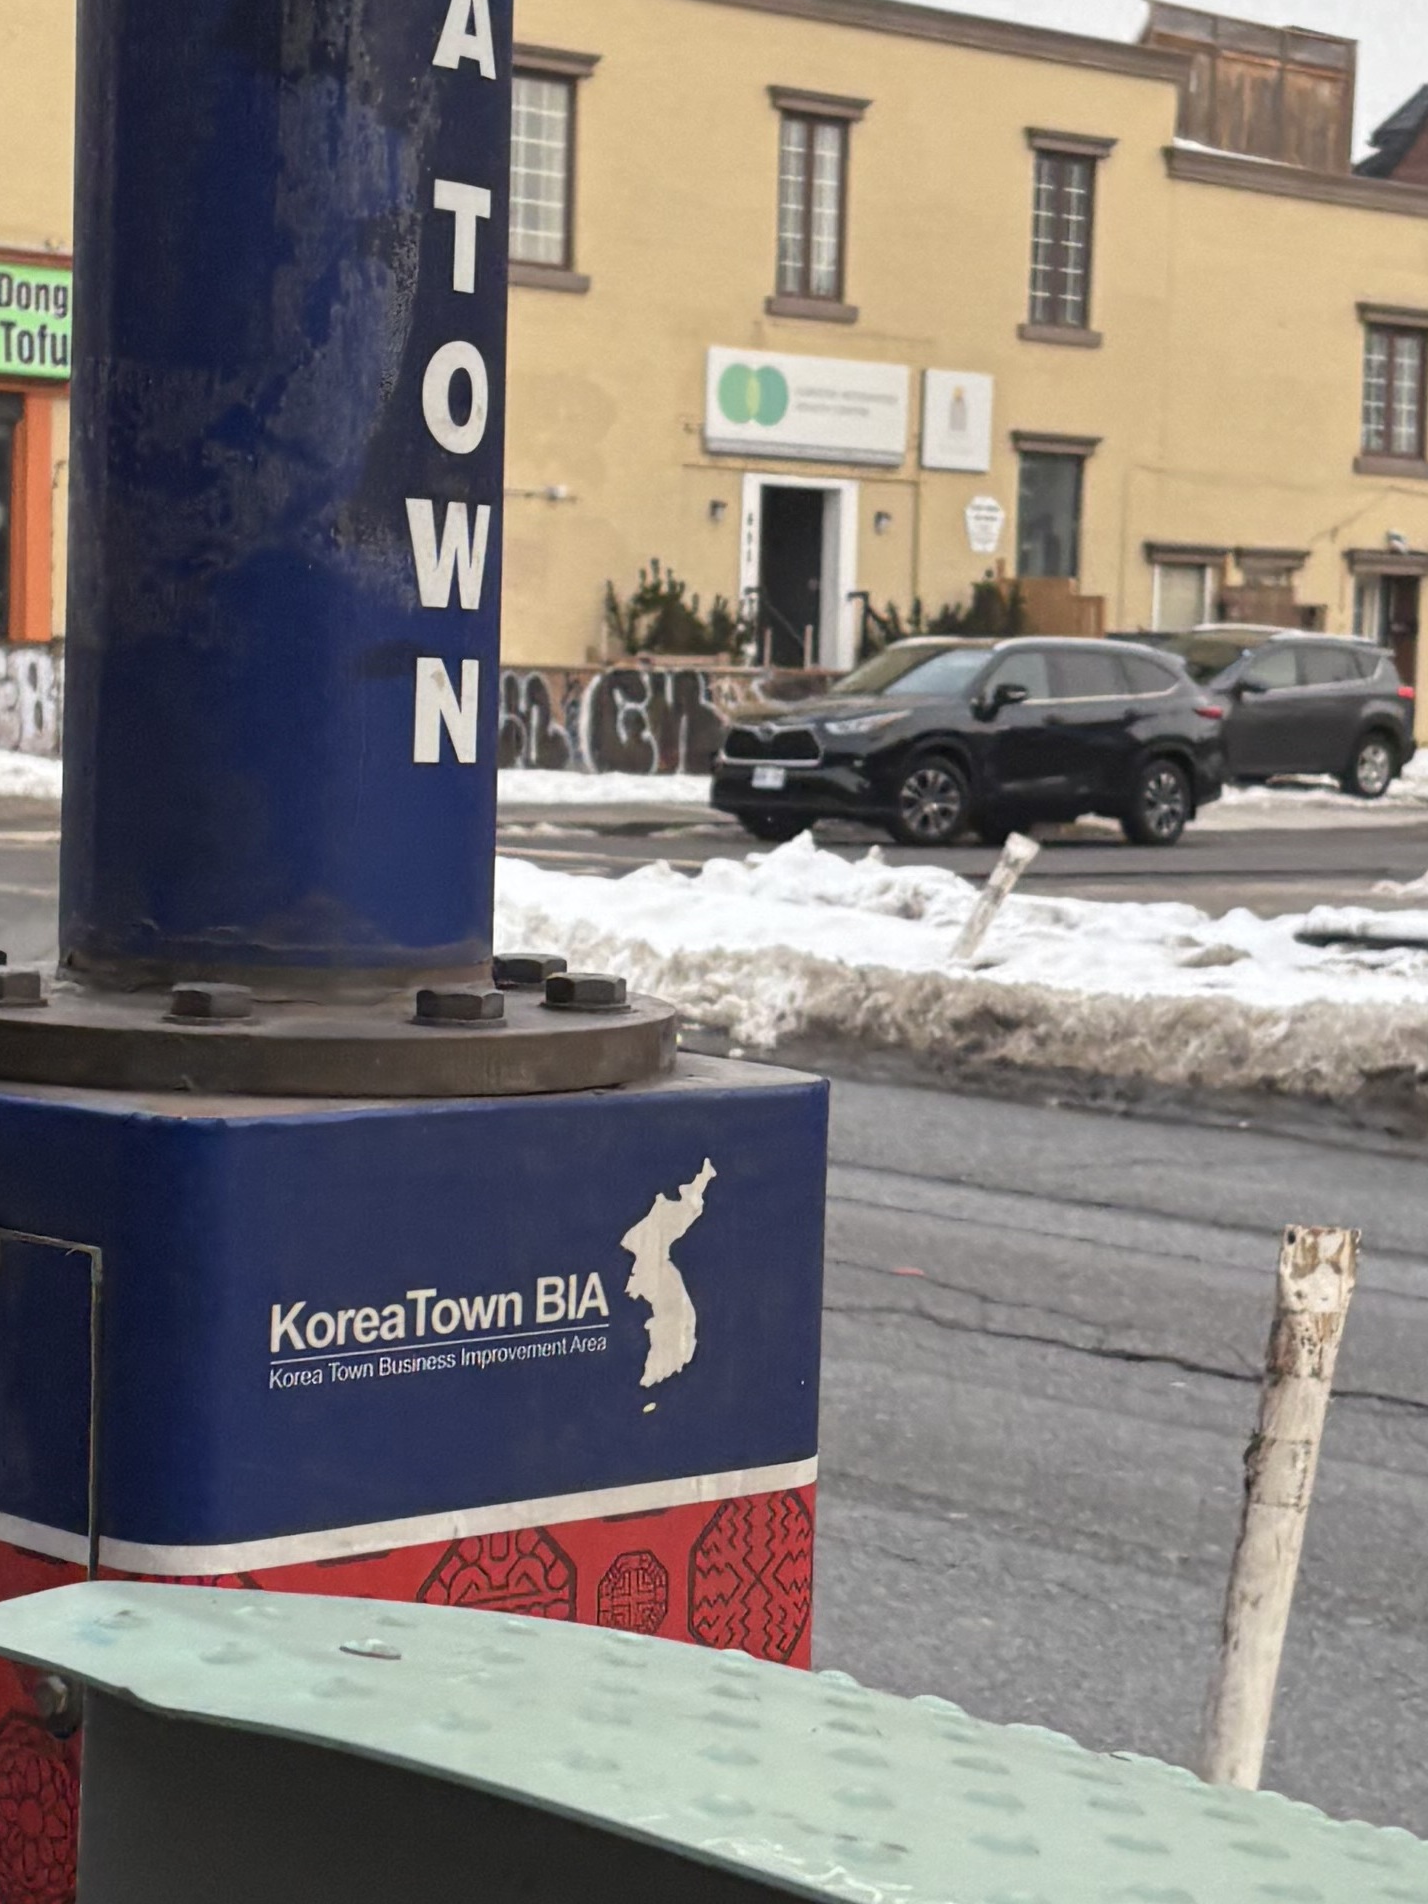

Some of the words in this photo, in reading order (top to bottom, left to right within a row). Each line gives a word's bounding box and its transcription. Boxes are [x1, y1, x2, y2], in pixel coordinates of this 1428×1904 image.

[270, 1287, 523, 1353] KoreaTown
[536, 1272, 610, 1324] BIA
[269, 1366, 323, 1390] Korea
[328, 1360, 374, 1383] Town
[378, 1352, 457, 1377] Business
[461, 1338, 568, 1370] Improvement
[570, 1333, 607, 1353] Area
